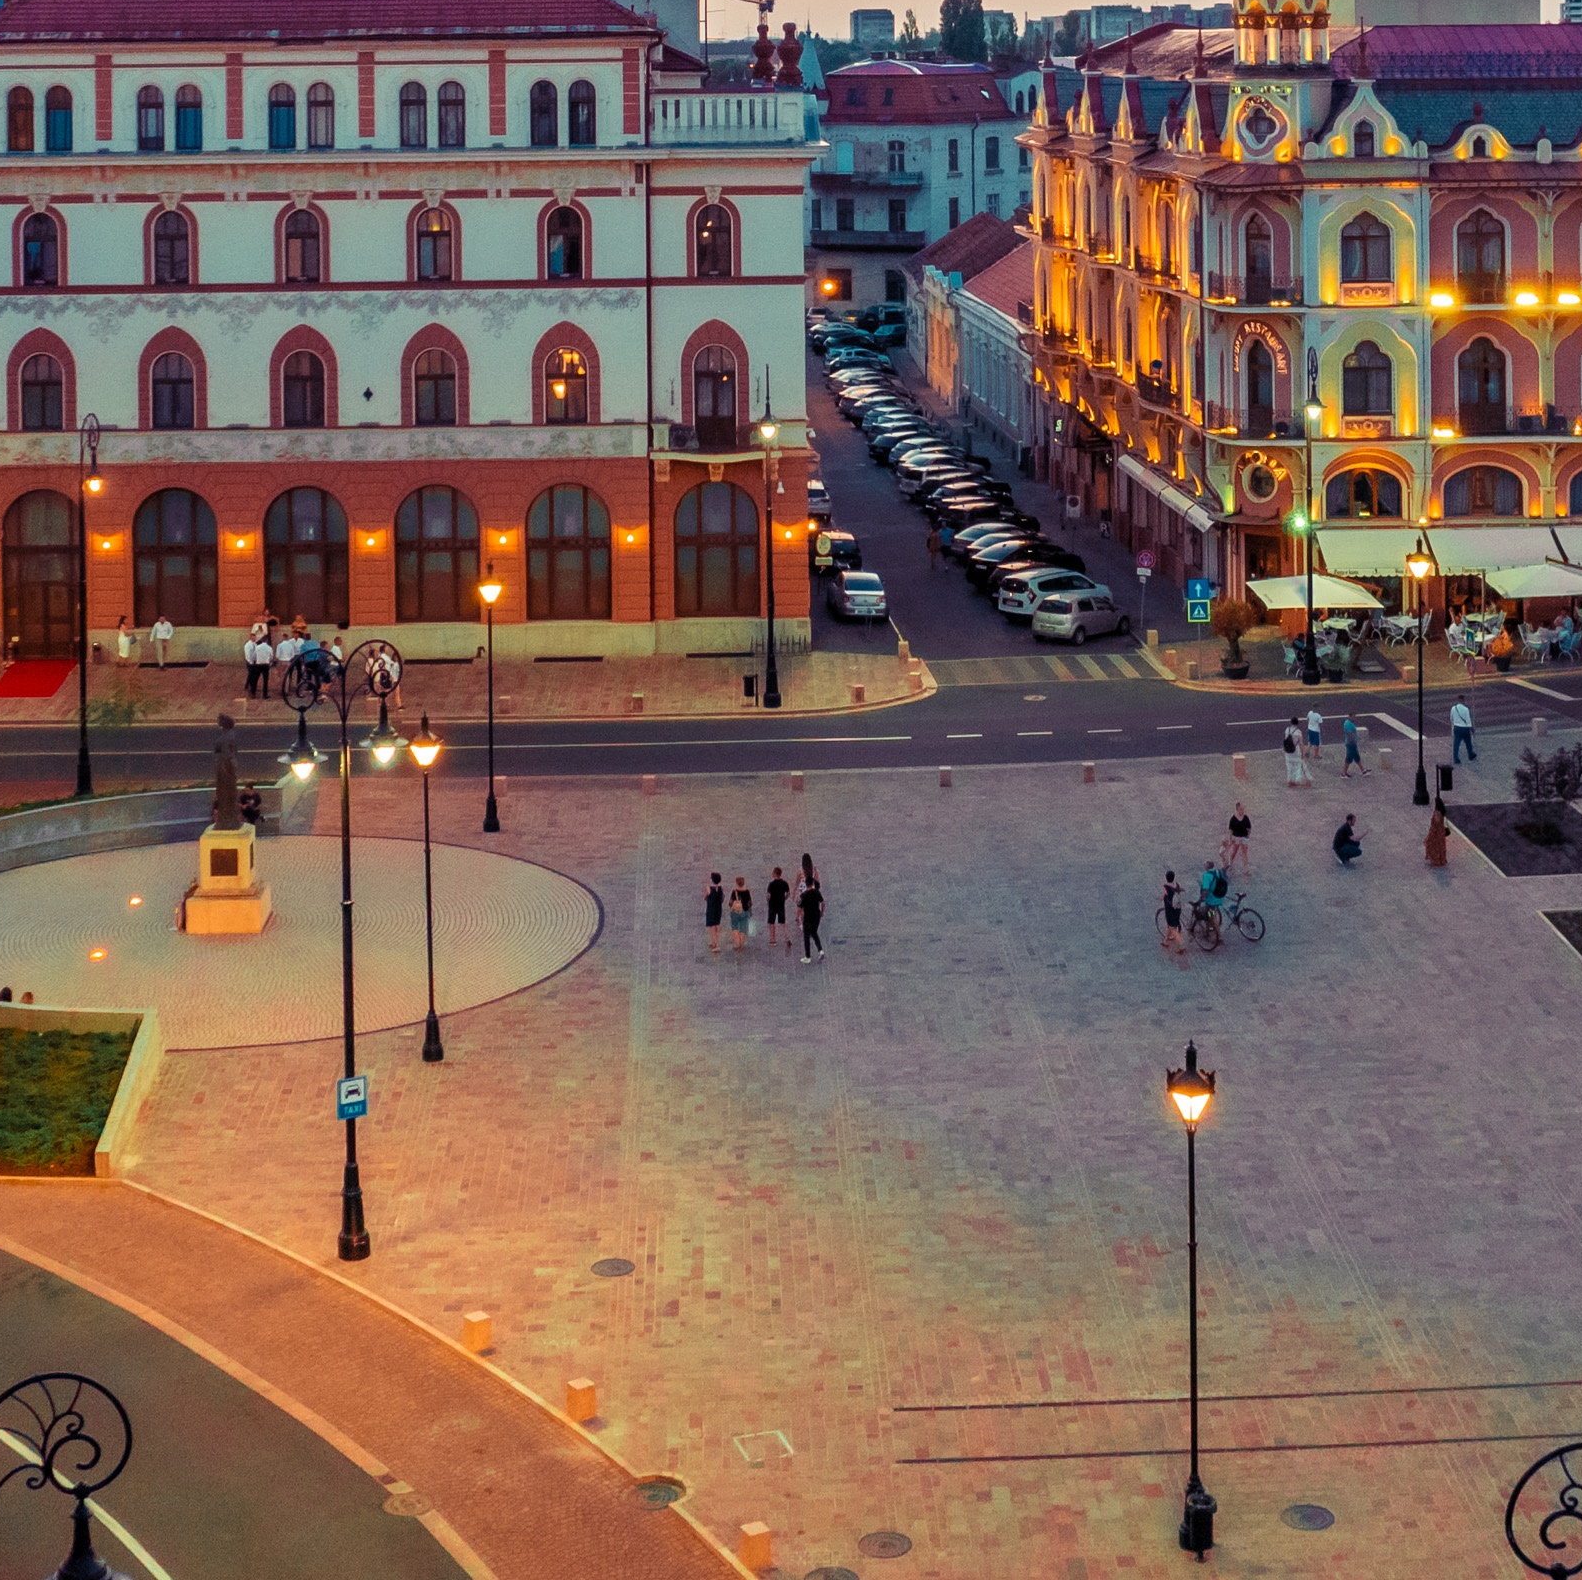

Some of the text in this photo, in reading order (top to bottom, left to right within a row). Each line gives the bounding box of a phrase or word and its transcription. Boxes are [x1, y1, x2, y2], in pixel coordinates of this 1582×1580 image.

[1244, 321, 1288, 375] RESTAURANT
[1237, 449, 1288, 482] ATORIA
[344, 1104, 363, 1115] TAXI
